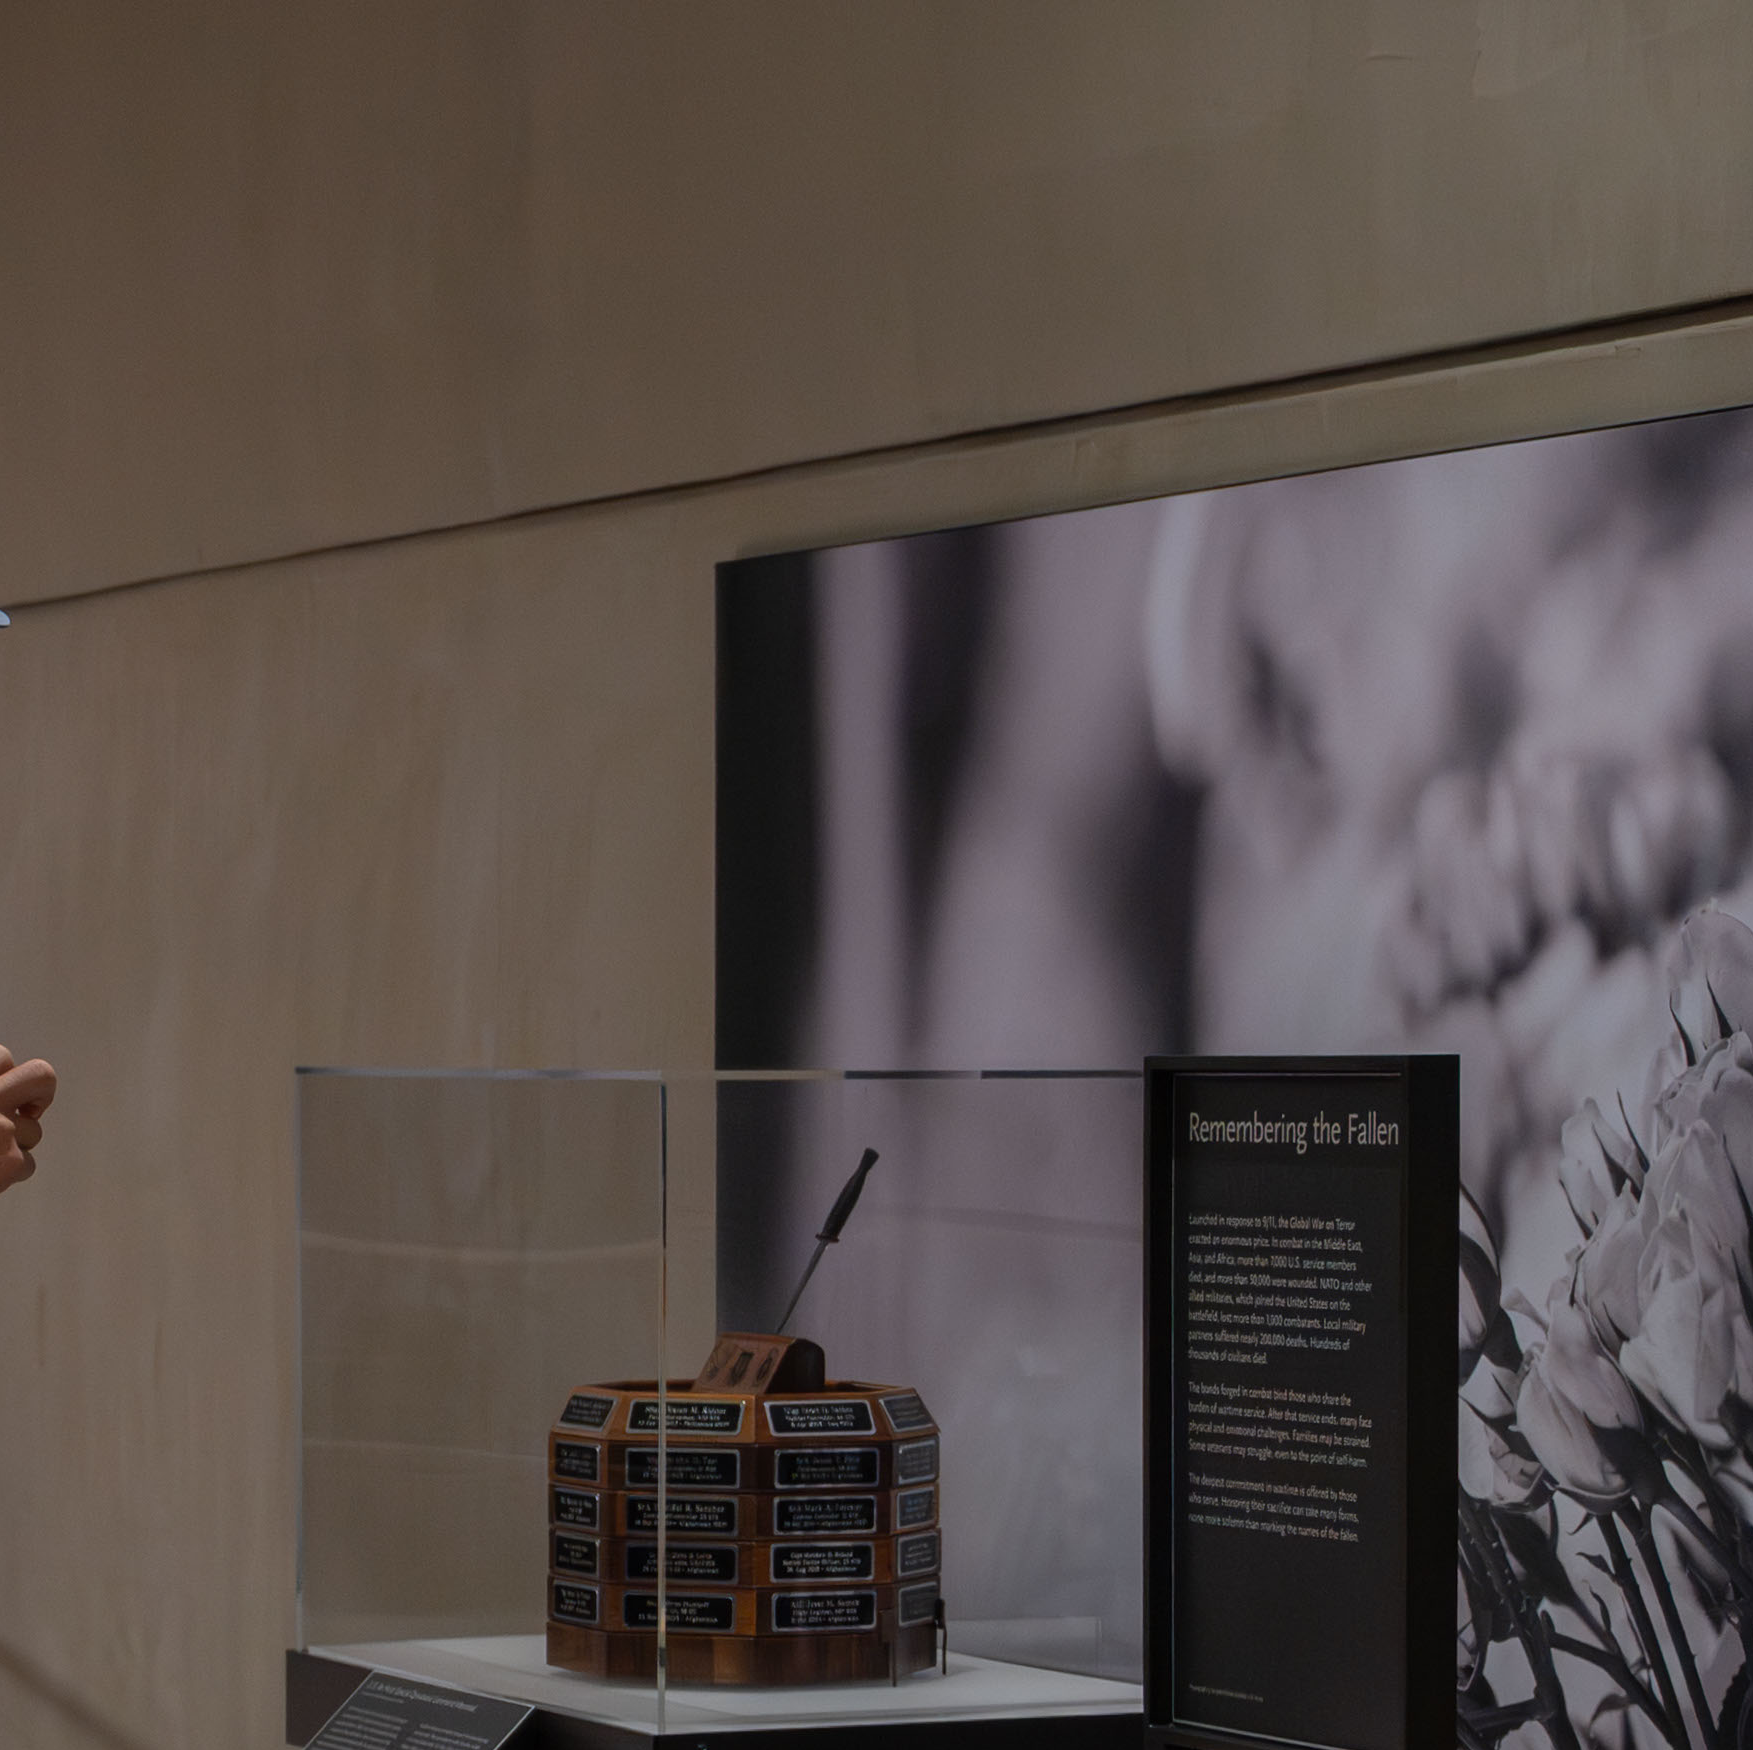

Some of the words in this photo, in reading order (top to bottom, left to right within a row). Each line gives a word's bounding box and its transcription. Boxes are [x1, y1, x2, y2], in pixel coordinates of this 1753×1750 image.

[1189, 1110, 1307, 1155] Remembering
[1312, 1110, 1341, 1144] the
[1347, 1111, 1399, 1145] Fallen
[1218, 1214, 1224, 1225] in
[1226, 1218, 1254, 1228] response
[1255, 1217, 1261, 1226] to
[1262, 1216, 1277, 1229] 9/11,
[1278, 1216, 1288, 1227] the
[1289, 1217, 1310, 1228] Global
[1311, 1217, 1324, 1229] War
[1325, 1221, 1334, 1229] on
[1336, 1218, 1355, 1230] Terror
[1253, 1235, 1270, 1249] price.
[1271, 1235, 1278, 1247] In
[1279, 1236, 1303, 1248] combat
[1304, 1237, 1310, 1248] in
[1311, 1237, 1322, 1249] the
[1323, 1238, 1346, 1250] Middle
[1347, 1239, 1363, 1252] East,
[1204, 1253, 1216, 1264] and
[1237, 1257, 1253, 1266] more
[1254, 1255, 1268, 1267] than
[1288, 1257, 1300, 1268] U.S.
[1302, 1258, 1325, 1270] service
[1326, 1259, 1356, 1271] members
[1204, 1272, 1216, 1283] and
[1217, 1275, 1233, 1284] more
[1234, 1273, 1248, 1285] than
[1271, 1278, 1286, 1287] were
[1319, 1278, 1339, 1290] NATO
[1341, 1279, 1353, 1291] and
[1354, 1280, 1372, 1292] other
[1235, 1293, 1253, 1305] which
[1254, 1294, 1273, 1308] joined
[1274, 1295, 1285, 1306] the
[1286, 1296, 1308, 1308] United
[1309, 1297, 1328, 1309] States
[1329, 1301, 1338, 1310] on
[1339, 1299, 1350, 1310] the
[1220, 1310, 1231, 1322] lost
[1233, 1315, 1249, 1323] more
[1250, 1313, 1265, 1324] than
[1323, 1317, 1340, 1329] Local
[1341, 1319, 1366, 1334] military
[1240, 1332, 1259, 1347] nearly
[1342, 1339, 1350, 1351] of
[1188, 1347, 1219, 1360] thousands
[1220, 1350, 1227, 1361] of
[1189, 1380, 1199, 1392] The
[1201, 1381, 1219, 1394] bonds
[1220, 1383, 1240, 1398] forged
[1241, 1385, 1248, 1397] in
[1249, 1387, 1272, 1399] combat
[1273, 1388, 1287, 1400] bind
[1288, 1389, 1305, 1402] those
[1307, 1391, 1321, 1403] who
[1322, 1392, 1339, 1405] share
[1340, 1394, 1351, 1406] the
[1188, 1400, 1209, 1413] burden
[1210, 1402, 1217, 1414] of
[1218, 1404, 1242, 1416] wartime
[1243, 1406, 1265, 1418] service.
[1284, 1409, 1297, 1421] that
[1298, 1411, 1320, 1423] service
[1340, 1417, 1357, 1430] many
[1358, 1415, 1372, 1428] face
[1188, 1420, 1212, 1434] physical
[1213, 1422, 1224, 1434] and
[1292, 1429, 1318, 1443] Families
[1319, 1435, 1332, 1447] may
[1333, 1433, 1342, 1445] be
[1189, 1438, 1206, 1451] Some
[1233, 1446, 1246, 1458] may
[1274, 1450, 1289, 1460] even
[1290, 1450, 1297, 1460] to
[1298, 1449, 1309, 1462] the
[1310, 1451, 1327, 1465] point
[1328, 1453, 1335, 1464] of
[1188, 1472, 1200, 1484] The
[1265, 1480, 1272, 1492] in
[1273, 1483, 1298, 1495] wartime
[1300, 1484, 1305, 1496] is
[1306, 1485, 1329, 1498] offered
[1330, 1487, 1338, 1502] by
[1339, 1488, 1357, 1501] those
[1188, 1491, 1201, 1503] who
[1251, 1498, 1265, 1511] their
[1266, 1501, 1291, 1514] sacrifice
[1292, 1506, 1304, 1515] can
[1305, 1505, 1318, 1517] take
[1319, 1509, 1337, 1522] many
[1338, 1508, 1359, 1523] forms,
[1188, 1514, 1203, 1524] none
[1204, 1516, 1221, 1526] more
[1245, 1517, 1259, 1530] than
[1286, 1522, 1297, 1534] the
[1298, 1526, 1319, 1537] names
[1320, 1526, 1327, 1538] of
[1328, 1527, 1339, 1539] the
